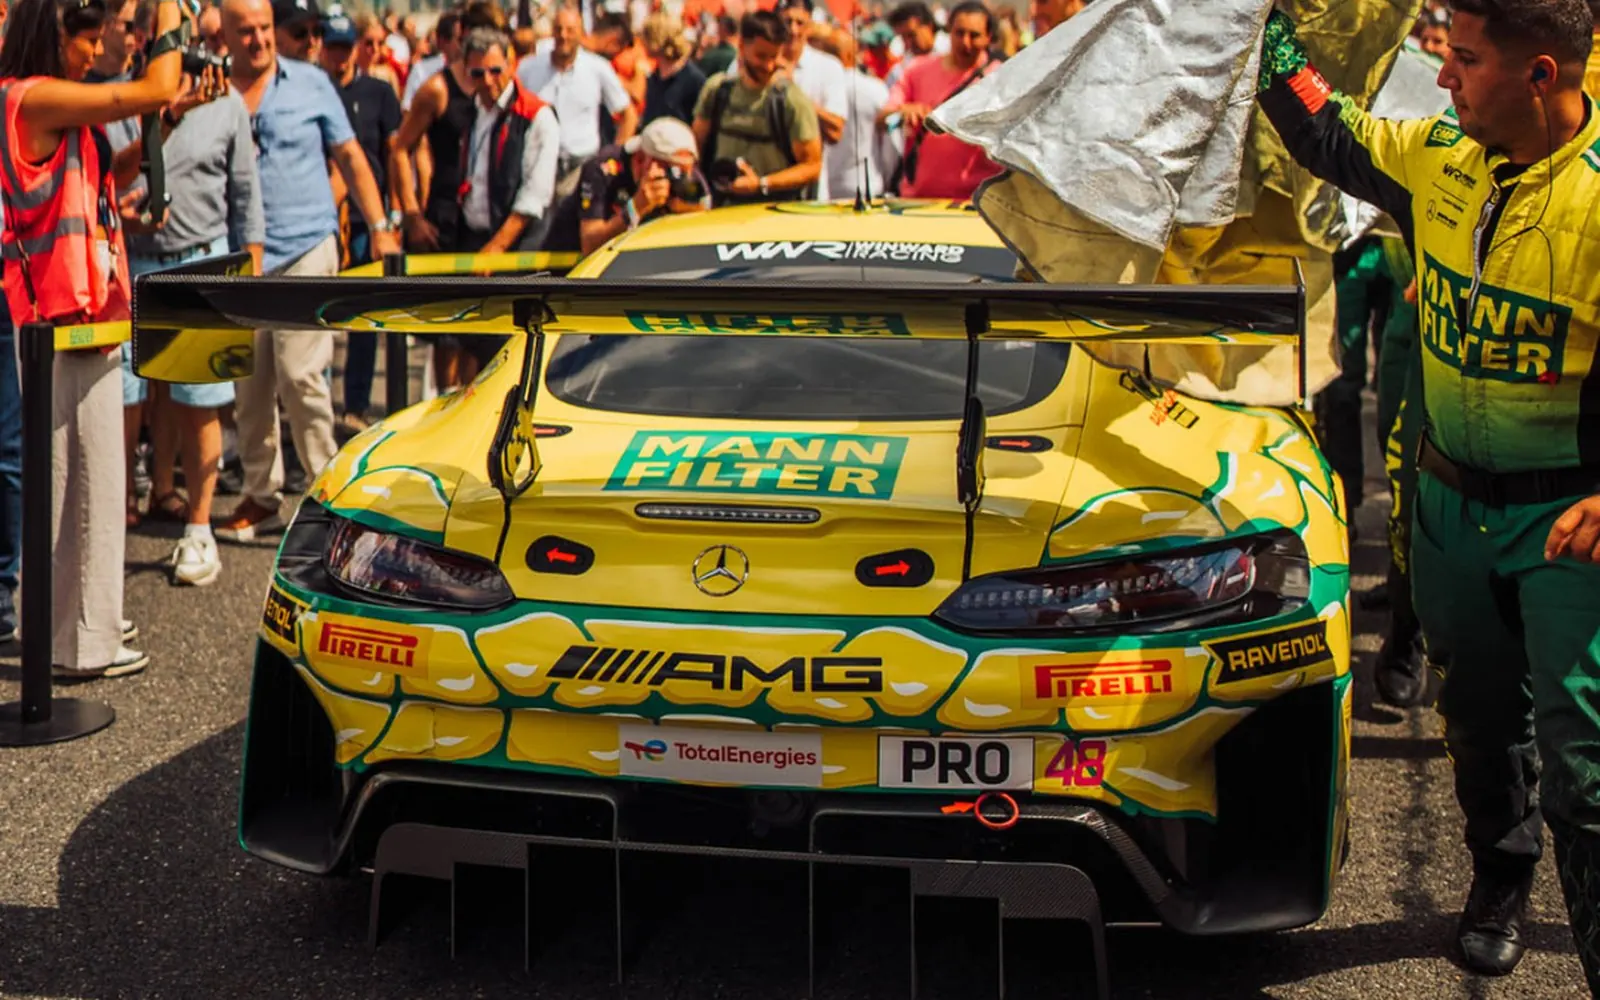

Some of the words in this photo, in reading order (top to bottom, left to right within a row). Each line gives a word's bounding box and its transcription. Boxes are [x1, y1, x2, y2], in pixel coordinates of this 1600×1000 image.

[847, 251, 963, 263] RACING
[851, 241, 965, 254] WINWARD
[1424, 301, 1552, 376] FILTER
[638, 436, 890, 465] MANN
[623, 461, 880, 495] FILTER
[318, 622, 419, 667] PIRELLI
[648, 652, 883, 693] AMG
[1034, 659, 1172, 699] PIRELLI
[674, 742, 817, 769] TotalEnergies
[902, 740, 1011, 785] PRO
[1044, 740, 1108, 788] 48
